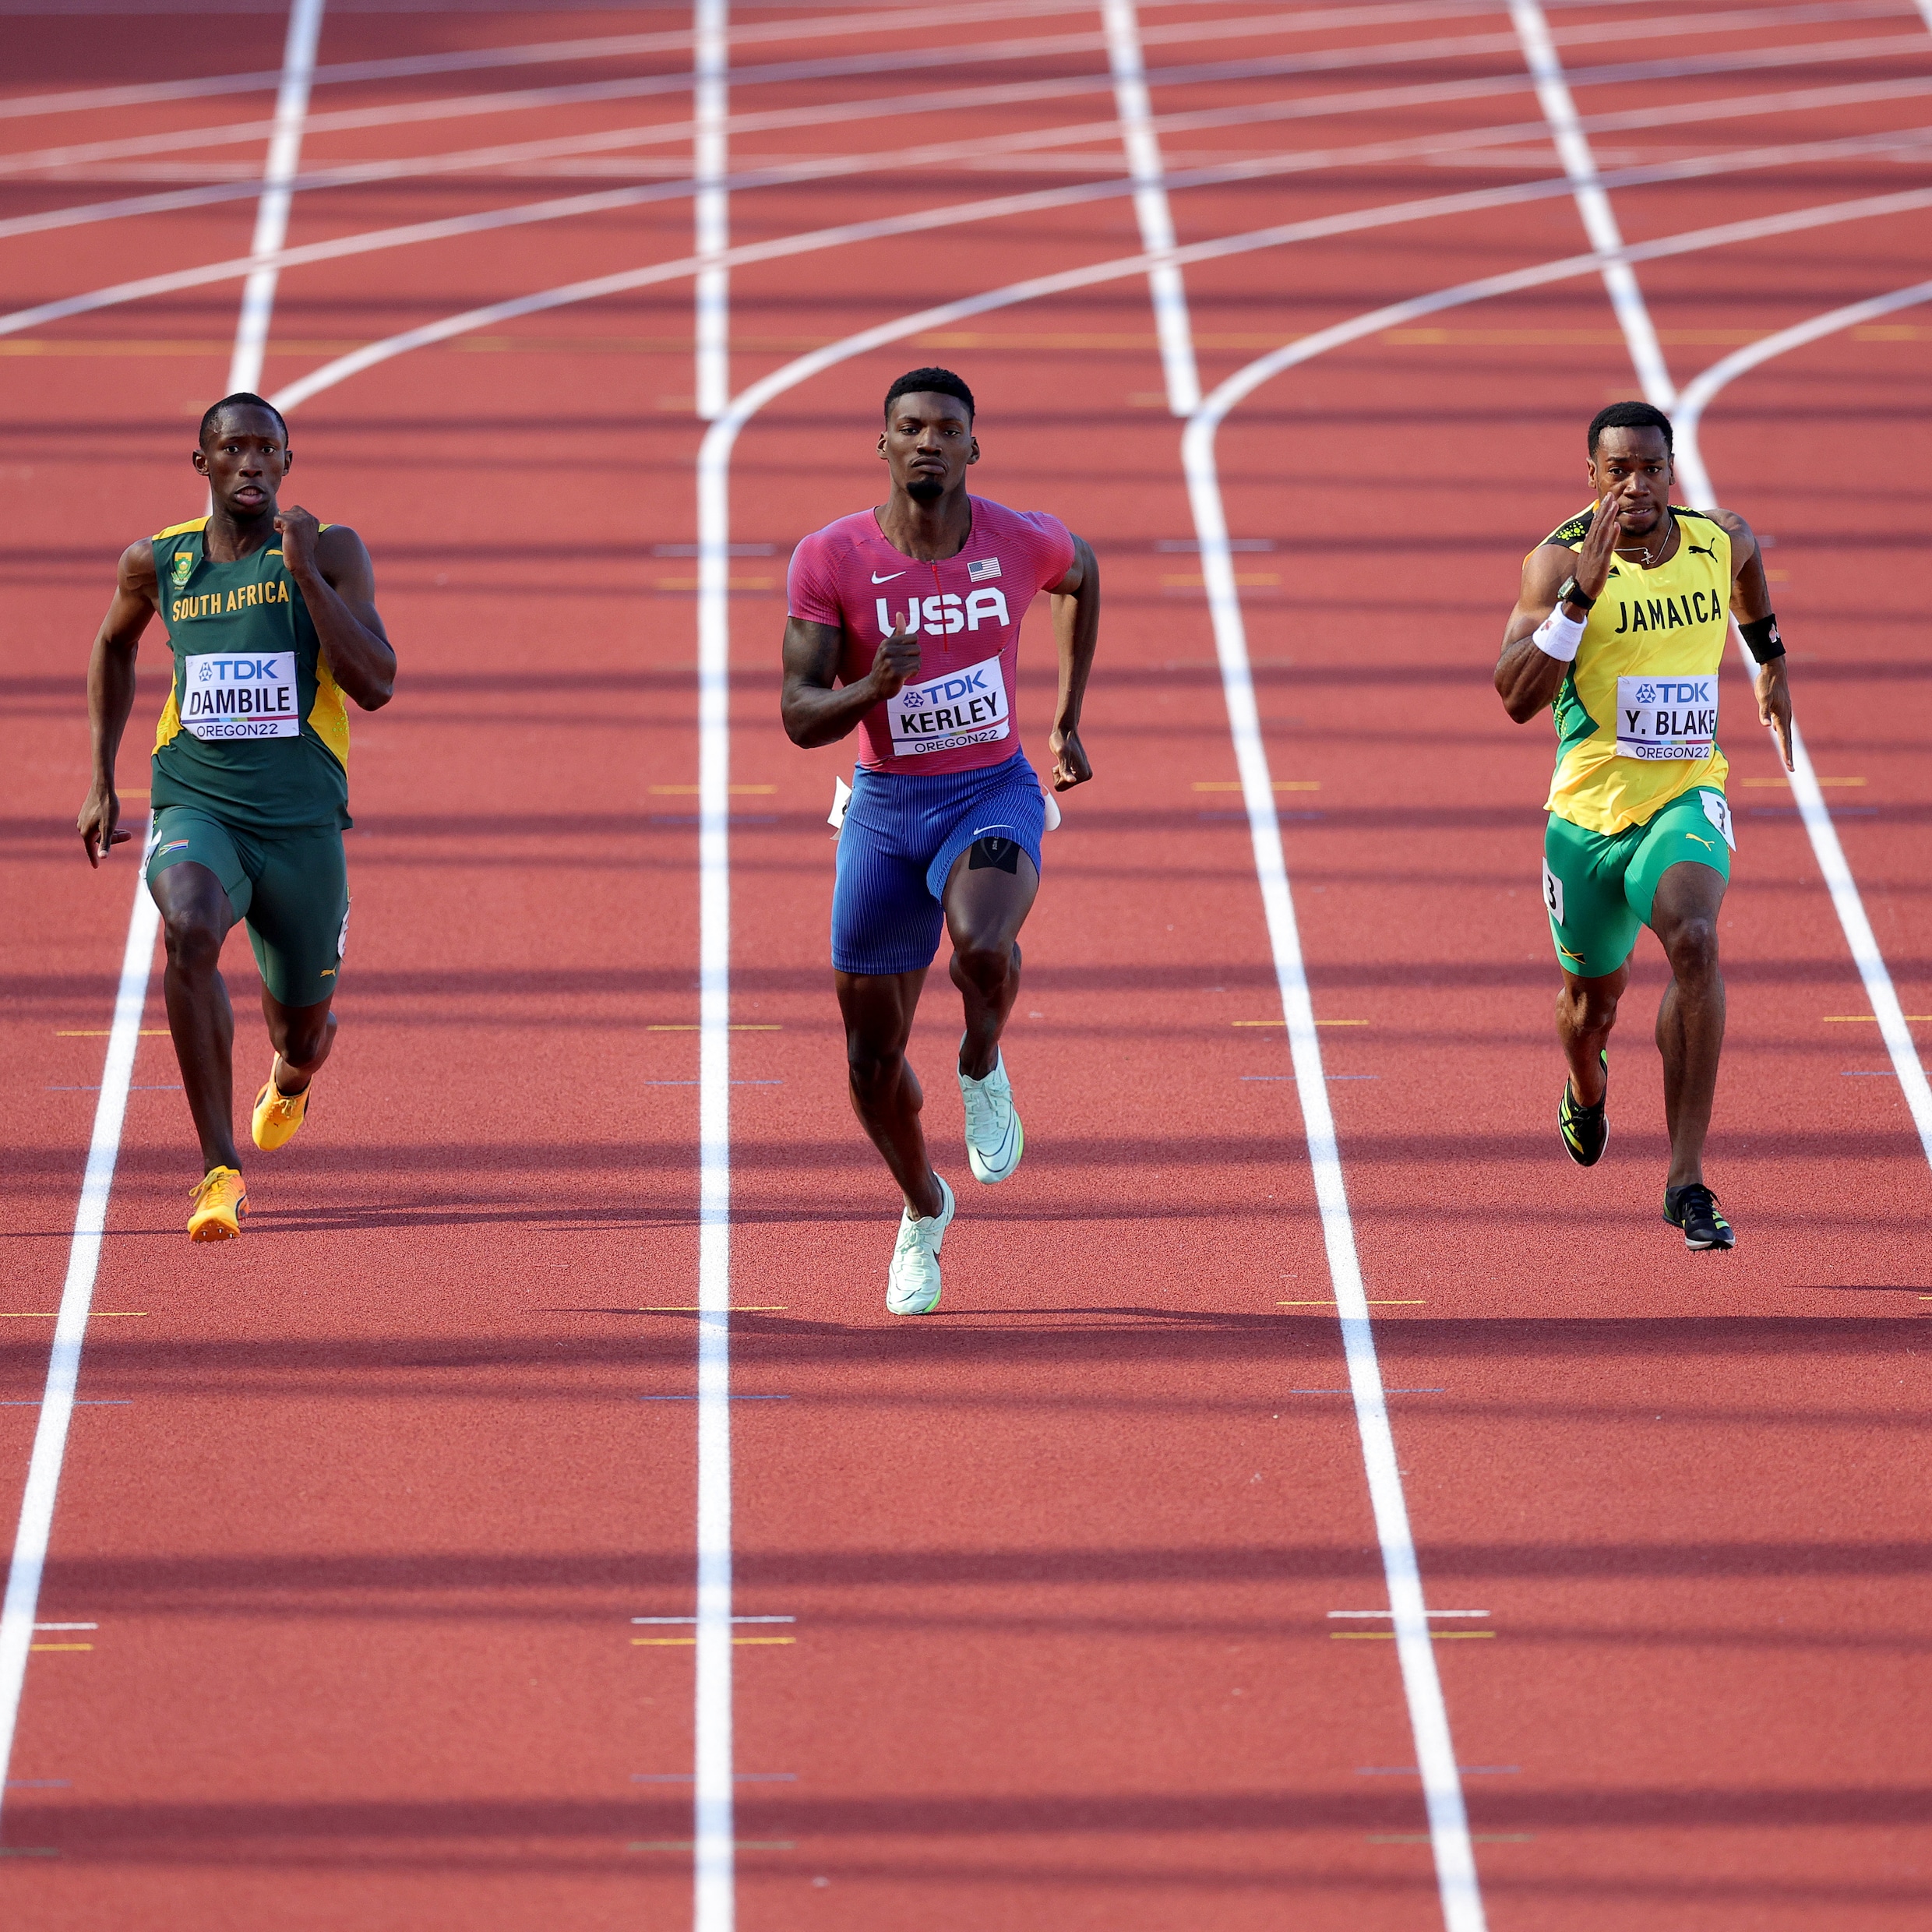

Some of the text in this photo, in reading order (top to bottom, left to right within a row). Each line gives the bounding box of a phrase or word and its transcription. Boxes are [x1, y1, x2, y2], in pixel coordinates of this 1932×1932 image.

[172, 580, 290, 622] SOUTH AFRICA
[876, 587, 1010, 639] USA
[1614, 588, 1722, 634] JAMAICA
[213, 659, 278, 680] TDK
[189, 686, 291, 715] DAMBILE
[922, 669, 989, 704] TDK
[1655, 682, 1710, 703] TDK
[900, 691, 997, 735] KERLEY
[1625, 710, 1715, 735] Y. BLAKE
[196, 723, 278, 738] OREGON22
[915, 729, 999, 753] OREGON22
[1636, 746, 1709, 759] OREGON22
[1547, 874, 1557, 910] 3
